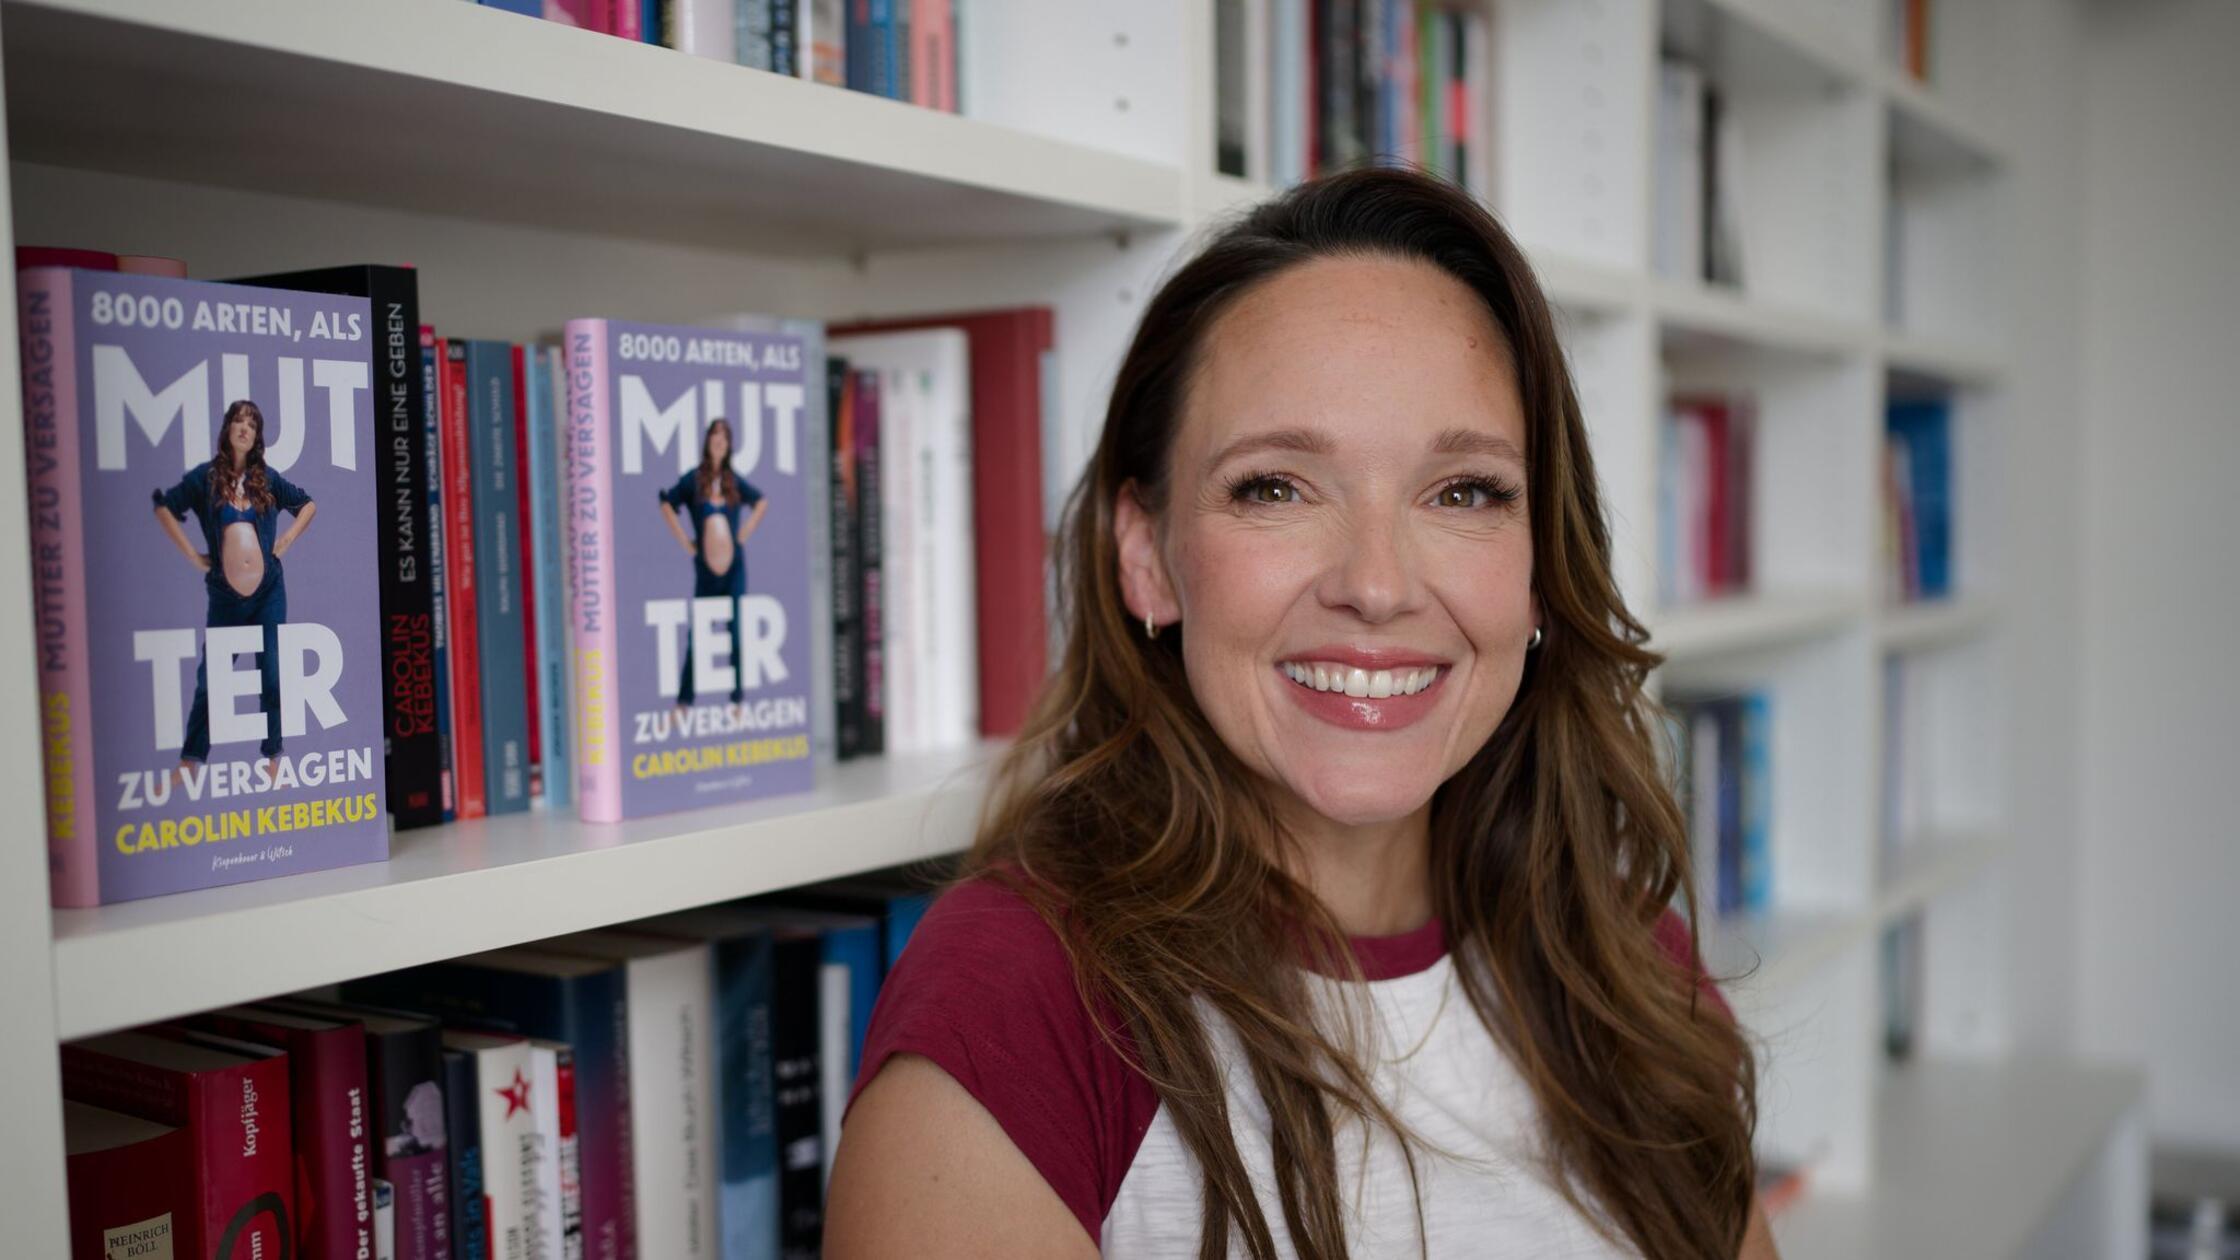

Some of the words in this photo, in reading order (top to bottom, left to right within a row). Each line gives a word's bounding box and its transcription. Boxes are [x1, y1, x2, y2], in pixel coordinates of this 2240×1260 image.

[92, 291, 183, 329] 8000
[192, 301, 301, 342] ARTEN,
[309, 311, 362, 341] ALS
[387, 302, 406, 377] GEBEN
[26, 289, 58, 477] VERSAGEN
[619, 333, 682, 363] 8000
[684, 339, 758, 371] ARTEN,
[762, 345, 800, 370] ALS
[93, 344, 369, 474] MUT
[391, 383, 409, 432] EINE
[573, 333, 596, 478] VERSAGEN
[619, 374, 804, 477] MUT
[393, 437, 411, 483] NUR
[34, 487, 61, 532] ZU
[395, 488, 414, 551] KANN
[579, 486, 598, 523] ZU
[399, 555, 416, 583] ES
[581, 531, 602, 633] MUTTER
[38, 542, 67, 672] MUTTER
[391, 613, 416, 738] CAROLIN
[410, 613, 434, 734] KEBEKUS
[645, 594, 788, 697] TER
[133, 622, 348, 751] TER
[584, 649, 606, 765] KEBEKUS
[635, 710, 671, 744] ZU
[672, 697, 805, 739] VERSAGEN
[47, 690, 76, 840] KEBEKUS
[117, 768, 172, 811] ZU
[179, 747, 372, 801] VERSAGEN
[633, 743, 725, 779] CAROLIN
[725, 735, 809, 768] KEBEKUS
[115, 809, 250, 855] CAROLIN
[257, 793, 377, 835] KEBEKUS
[241, 1076, 260, 1157] Kopfjäger
[347, 1088, 362, 1138] Staat
[352, 1144, 370, 1222] gekaufte
[127, 1241, 159, 1258] BÖLL
[356, 1228, 369, 1260] Der
